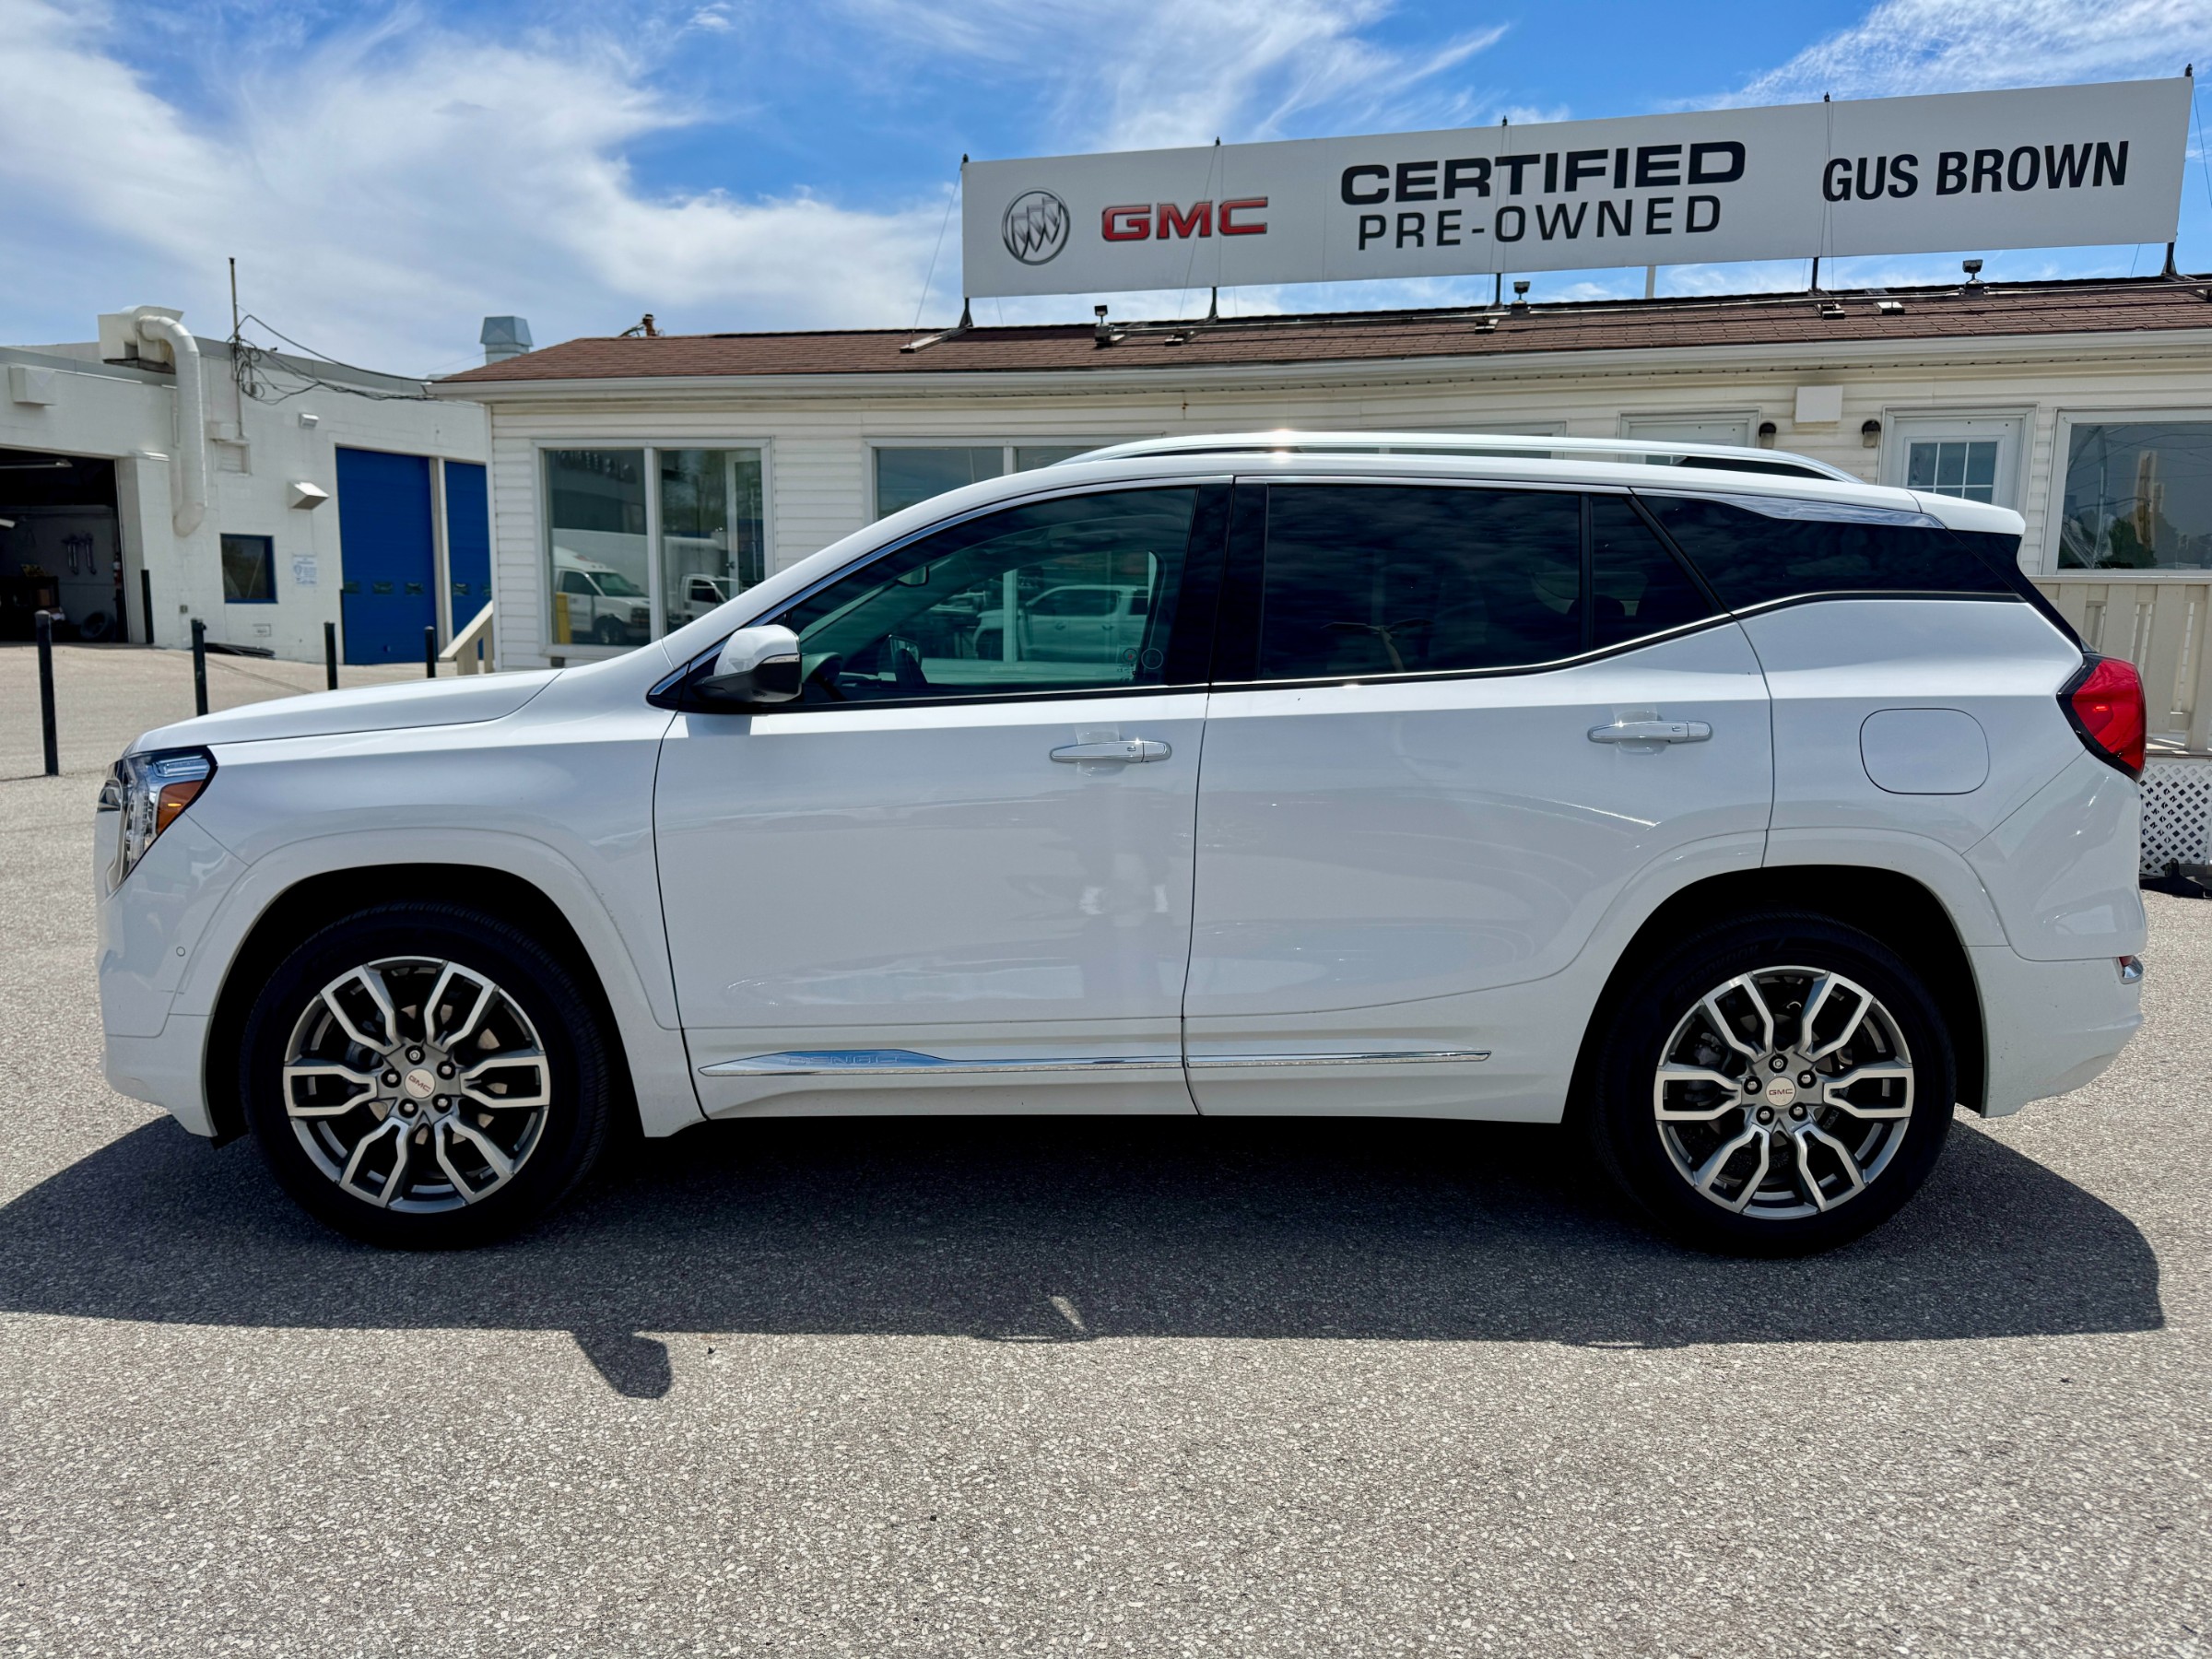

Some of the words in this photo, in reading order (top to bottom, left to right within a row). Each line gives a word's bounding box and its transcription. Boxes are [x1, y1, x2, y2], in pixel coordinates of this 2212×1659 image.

[1341, 141, 1746, 206] CERTIFIED
[1822, 153, 1918, 202] GUS
[1936, 140, 2129, 196] BROWN
[1101, 196, 1268, 241] GMC
[1358, 194, 1721, 251] PRE-OWNED
[409, 1076, 430, 1092] GMC
[787, 1055, 900, 1065] DENALI
